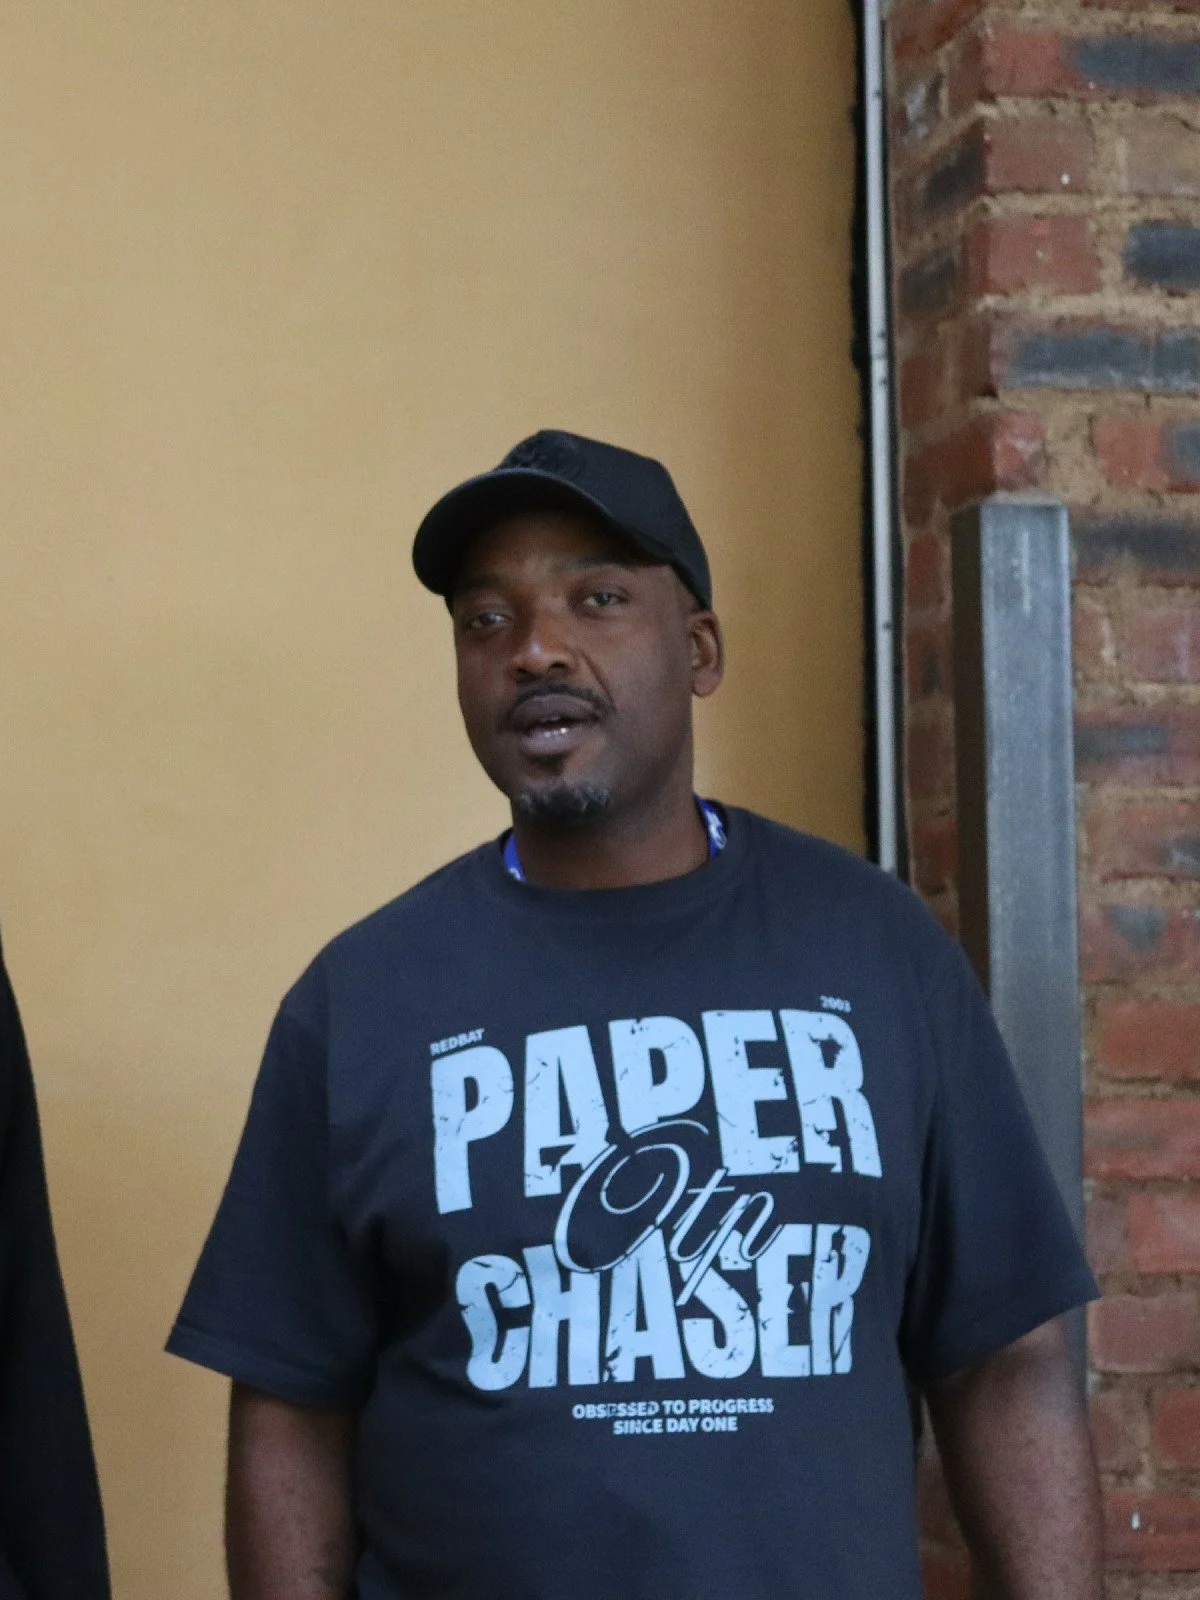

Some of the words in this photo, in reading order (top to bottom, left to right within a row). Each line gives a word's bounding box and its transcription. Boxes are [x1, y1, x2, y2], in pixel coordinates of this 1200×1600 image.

[429, 1028, 485, 1056] REDBAT
[430, 1008, 882, 1214] PAPER
[455, 1223, 871, 1392] CHASER
[571, 1401, 660, 1419] OBSESSED
[662, 1400, 687, 1415] TO
[688, 1398, 775, 1414] PROGRESS
[613, 1418, 664, 1435] SINCE
[665, 1417, 700, 1433] DAY
[700, 1416, 739, 1432] ONE
